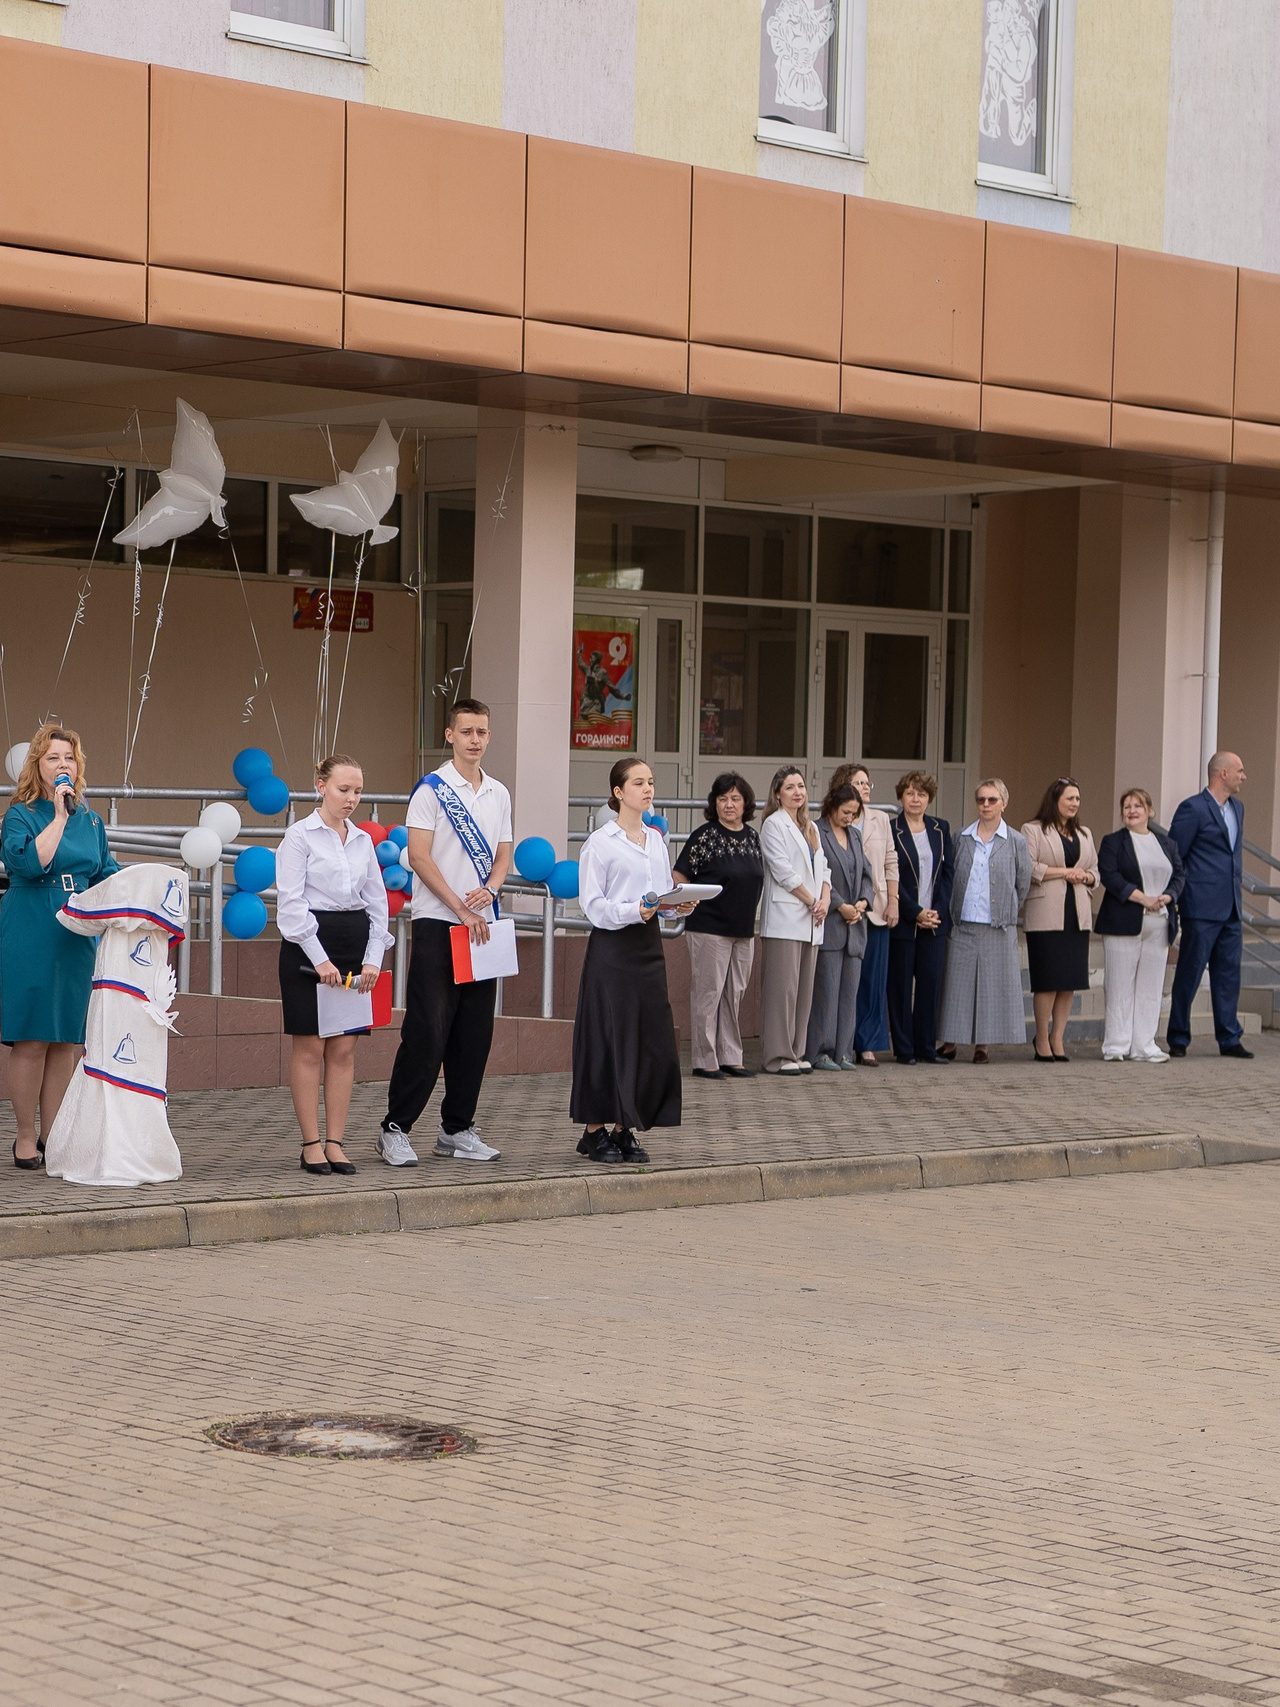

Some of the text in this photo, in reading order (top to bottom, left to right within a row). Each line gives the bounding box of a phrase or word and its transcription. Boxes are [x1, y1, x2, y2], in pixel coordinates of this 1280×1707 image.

[608, 636, 627, 666] 9
[575, 733, 629, 746] ГОРДИМСЯ!
[445, 801, 483, 854] Выпускник
